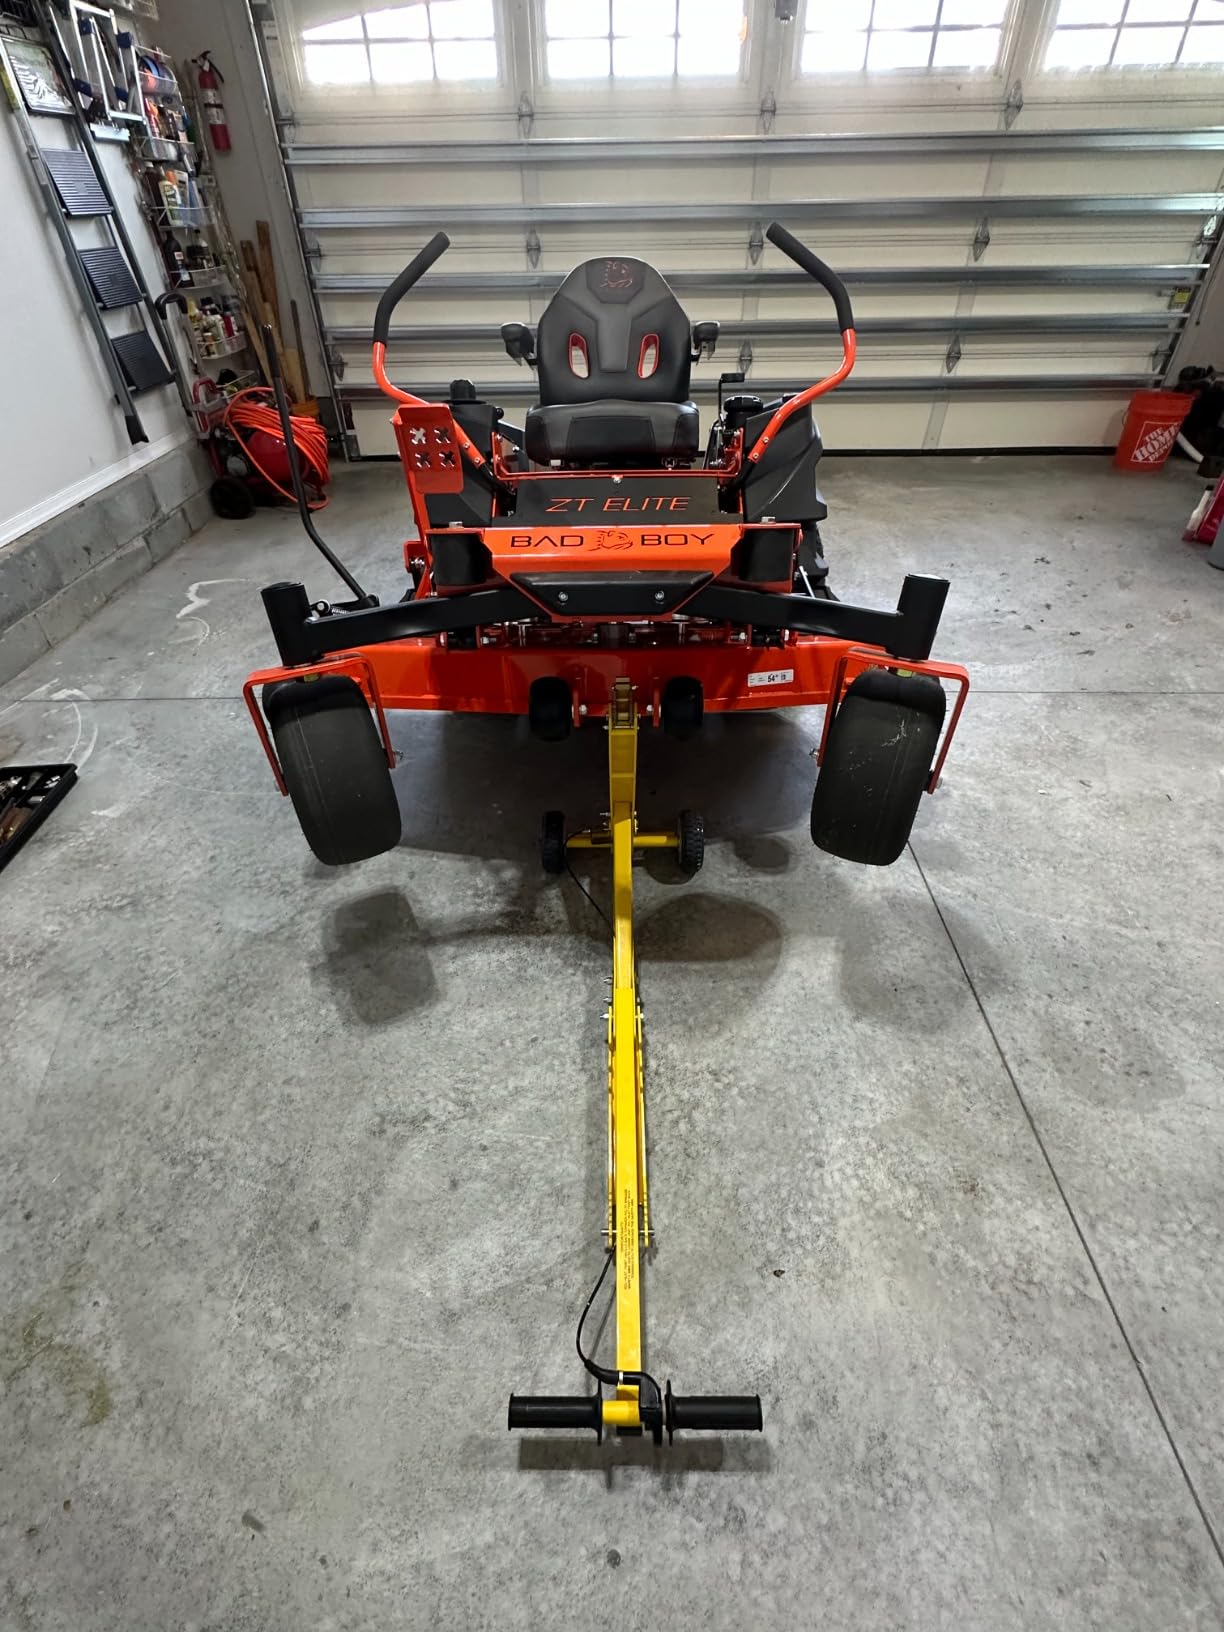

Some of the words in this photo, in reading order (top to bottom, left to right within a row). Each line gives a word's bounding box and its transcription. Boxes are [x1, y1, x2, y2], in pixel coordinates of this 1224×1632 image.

[1145, 427, 1163, 442] THE
[546, 498, 594, 512] ZT
[603, 497, 691, 512] ELITE
[510, 535, 584, 548] BAD
[641, 533, 715, 546] BOY
